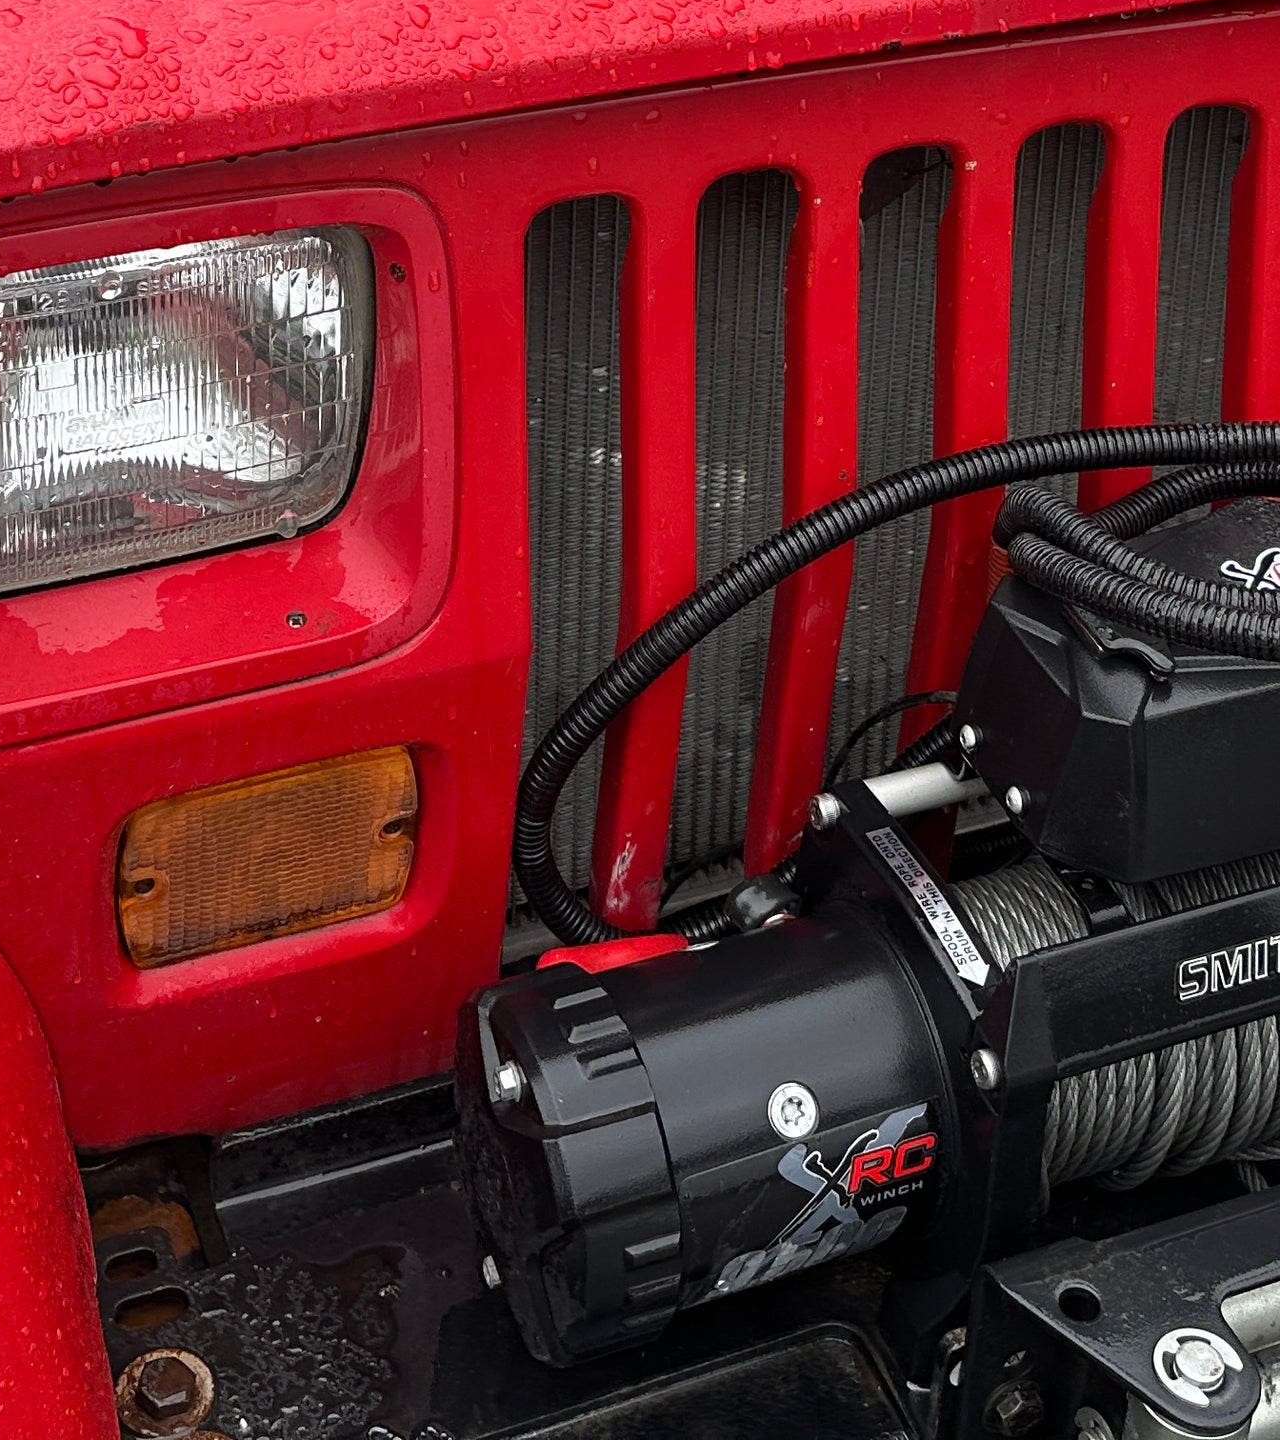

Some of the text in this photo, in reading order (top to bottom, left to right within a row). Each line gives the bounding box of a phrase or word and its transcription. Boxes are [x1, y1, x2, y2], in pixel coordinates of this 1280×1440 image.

[67, 421, 160, 449] HALOGEN
[871, 833, 968, 965] SPOOL WIRE ROPE ONTO
[882, 830, 978, 963] DRUM IN THIS DIRECTION
[860, 1180, 924, 1207] WINCH
